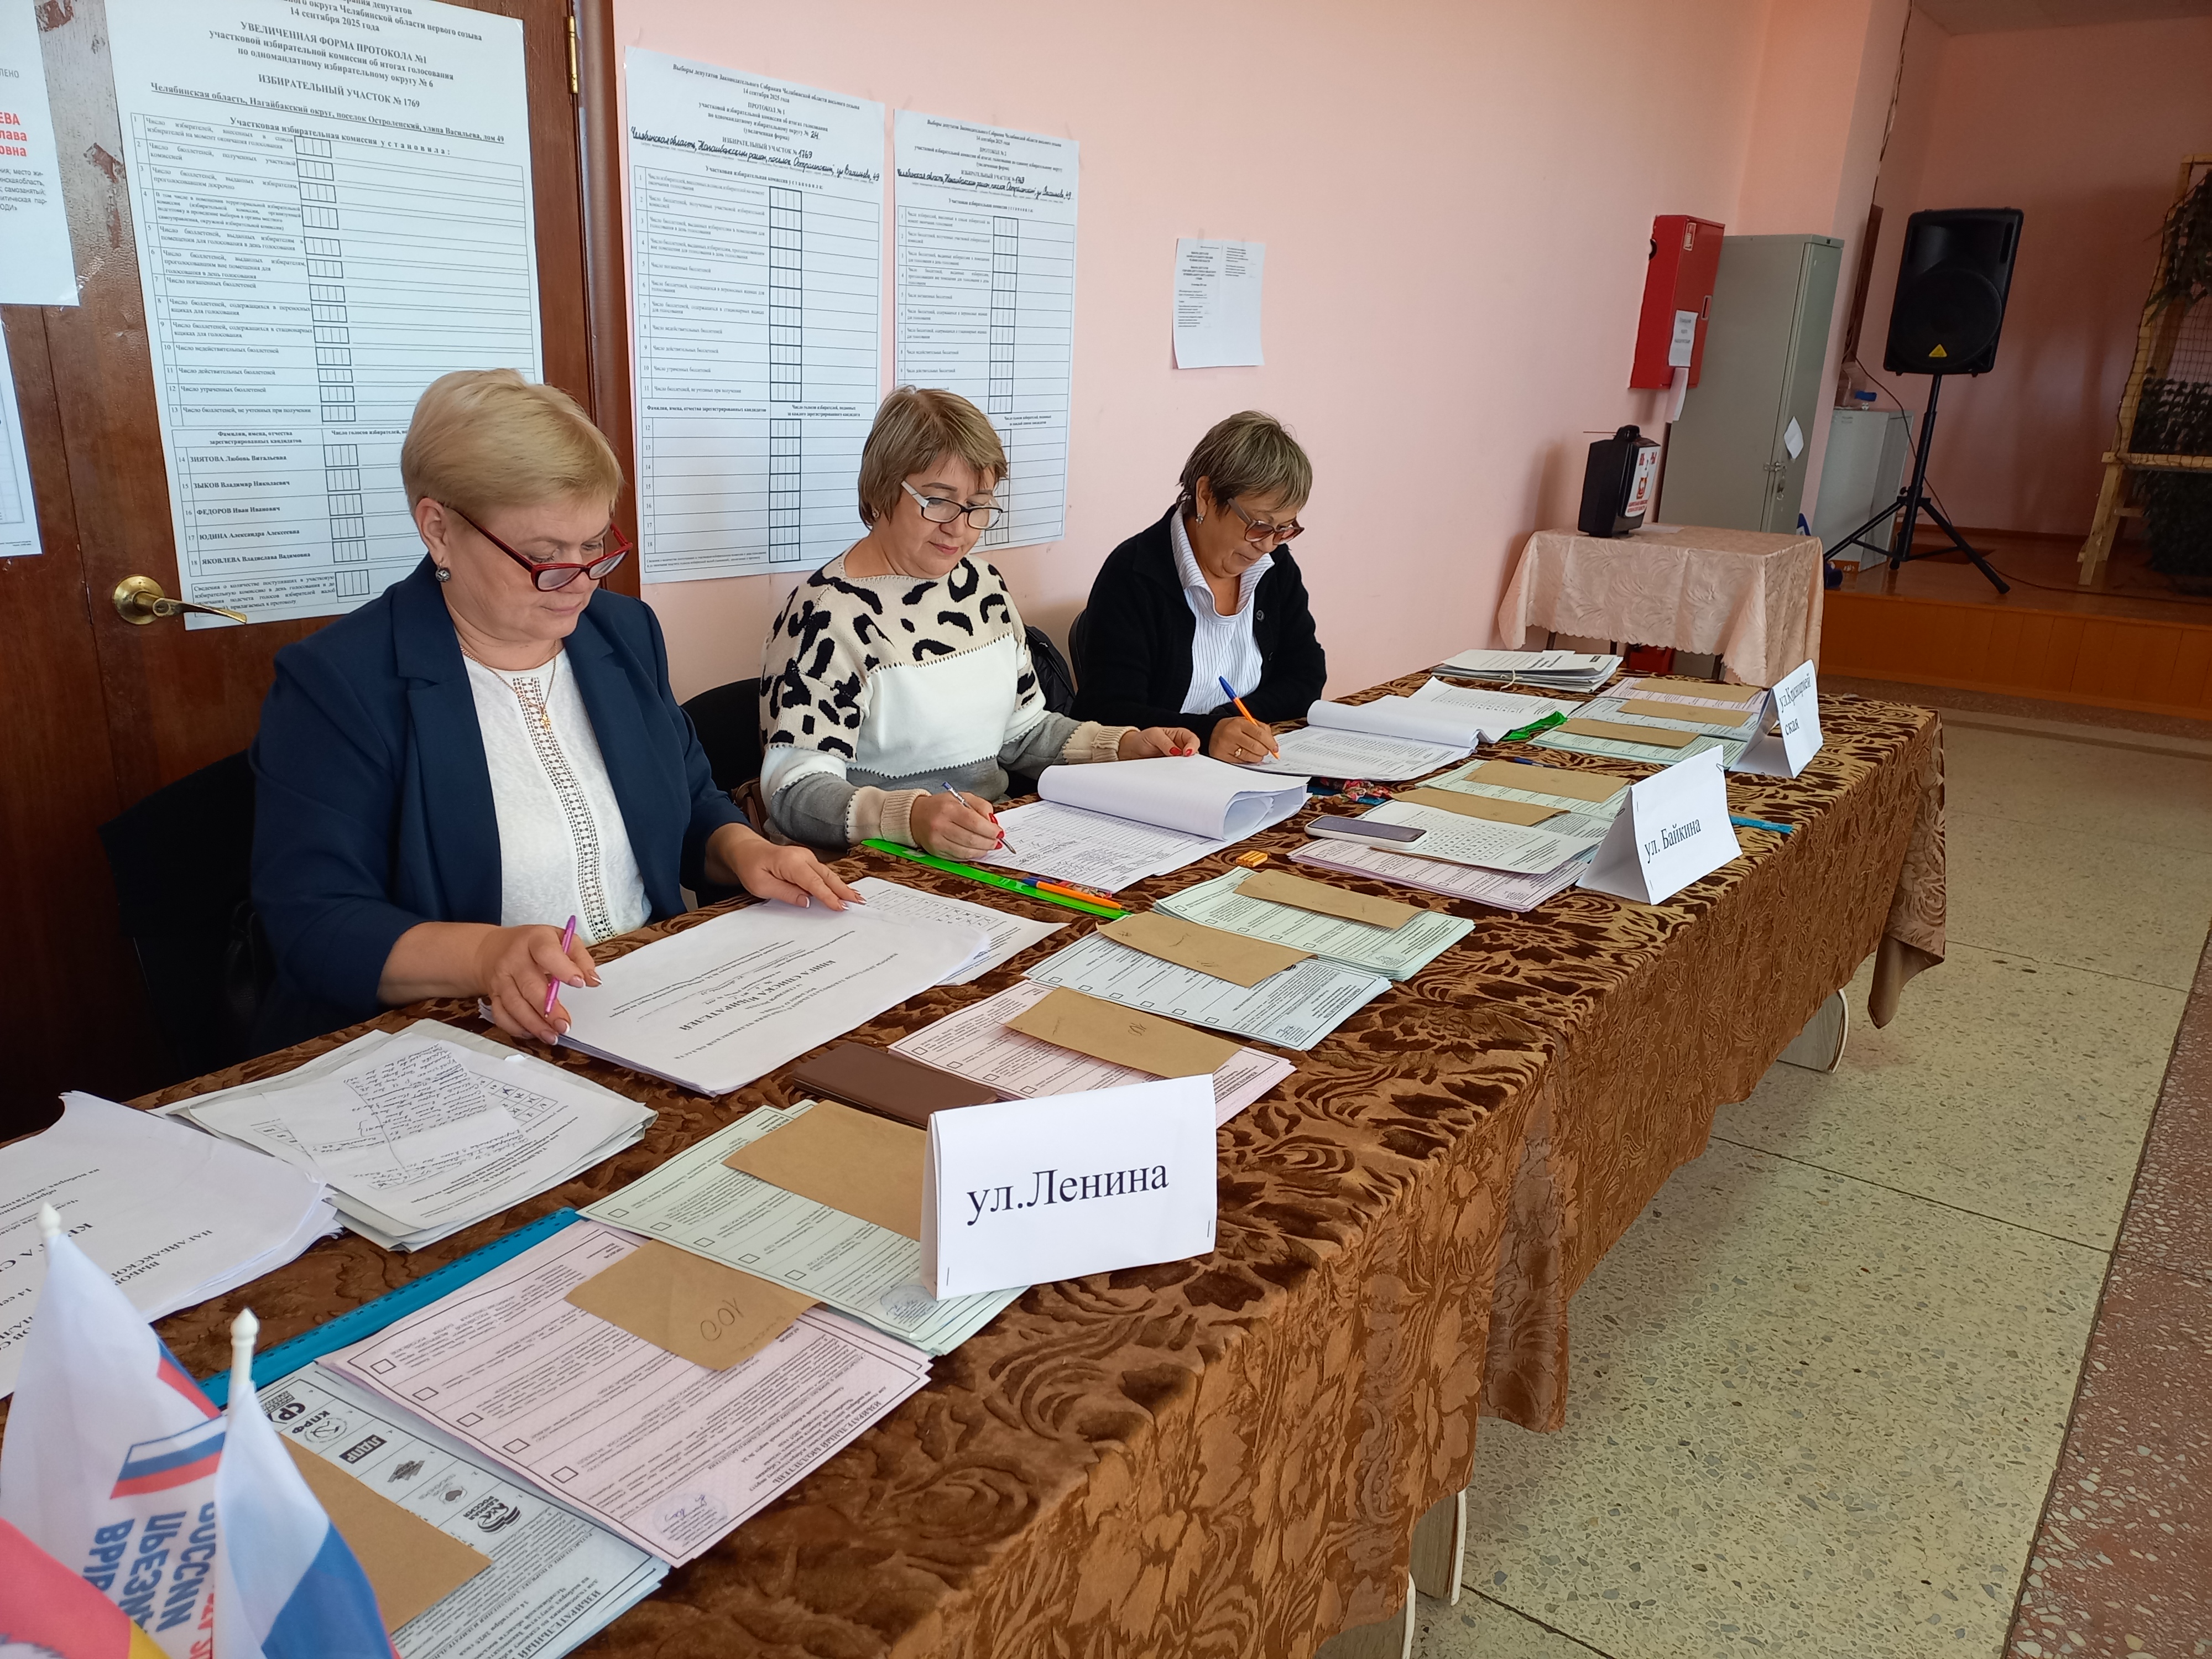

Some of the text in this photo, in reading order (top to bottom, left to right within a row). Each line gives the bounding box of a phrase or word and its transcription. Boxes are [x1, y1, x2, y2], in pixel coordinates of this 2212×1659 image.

[291, 7, 299, 15] 14
[302, 12, 340, 24] сентября
[342, 17, 360, 27] 2025
[241, 22, 317, 43] УВЕЛИЧЕННАЯ
[320, 37, 354, 50] ФОРМА
[357, 44, 412, 61] ПРОТОКОЛА
[264, 40, 326, 57] избирательной
[329, 53, 367, 64] комиссии
[324, 63, 388, 81] избирательному
[259, 74, 344, 96] ИЗБИРАТЕЛЬНЫЙ
[347, 89, 390, 103] УЧАСТОК
[404, 98, 419, 107] 1769
[1785, 718, 1799, 735] ская
[1645, 819, 1701, 864] ул. Байкина
[967, 1165, 1170, 1227] ул.Ленина
[292, 1411, 330, 1433] КПРФ
[343, 1436, 380, 1462] ЛДПР
